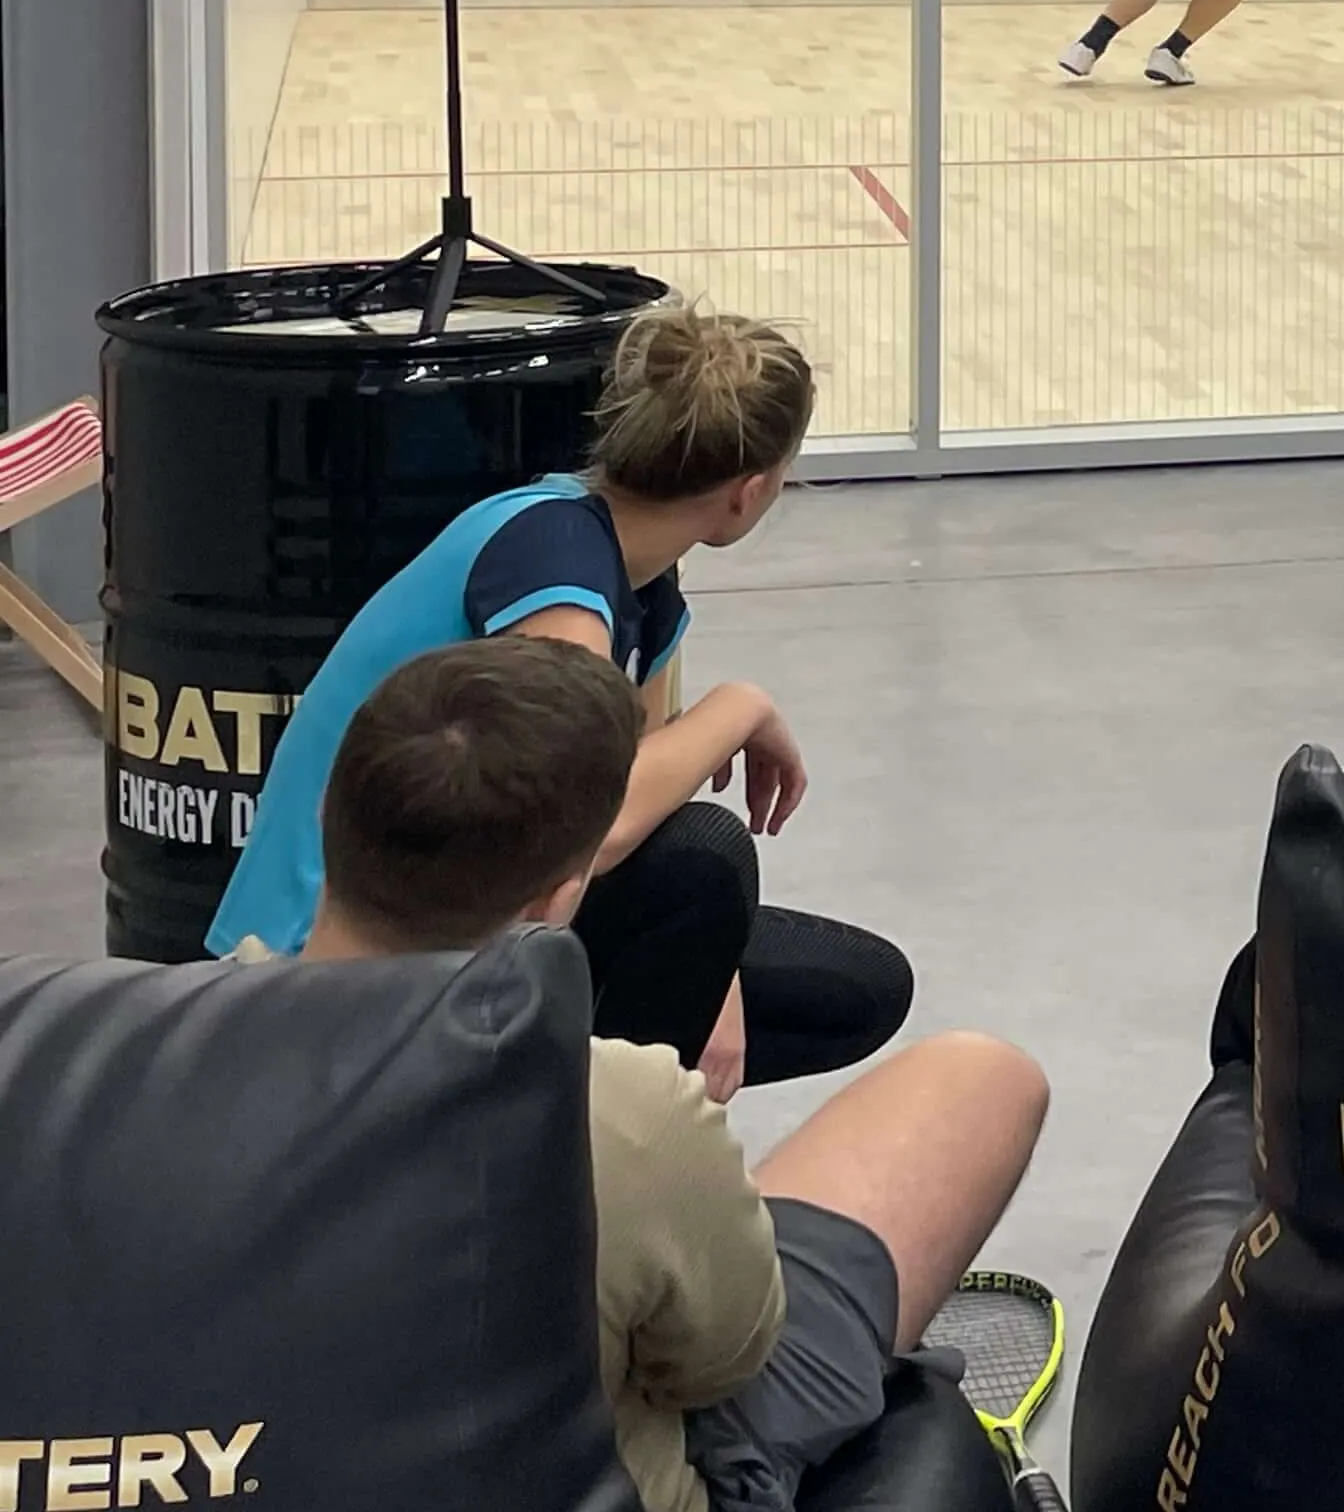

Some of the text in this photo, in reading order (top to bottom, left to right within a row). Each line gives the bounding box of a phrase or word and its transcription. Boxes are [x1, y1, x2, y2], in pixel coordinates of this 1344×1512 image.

[117, 669, 304, 775] BAT
[118, 768, 262, 848] ENERGY D
[1231, 1211, 1281, 1299] FO
